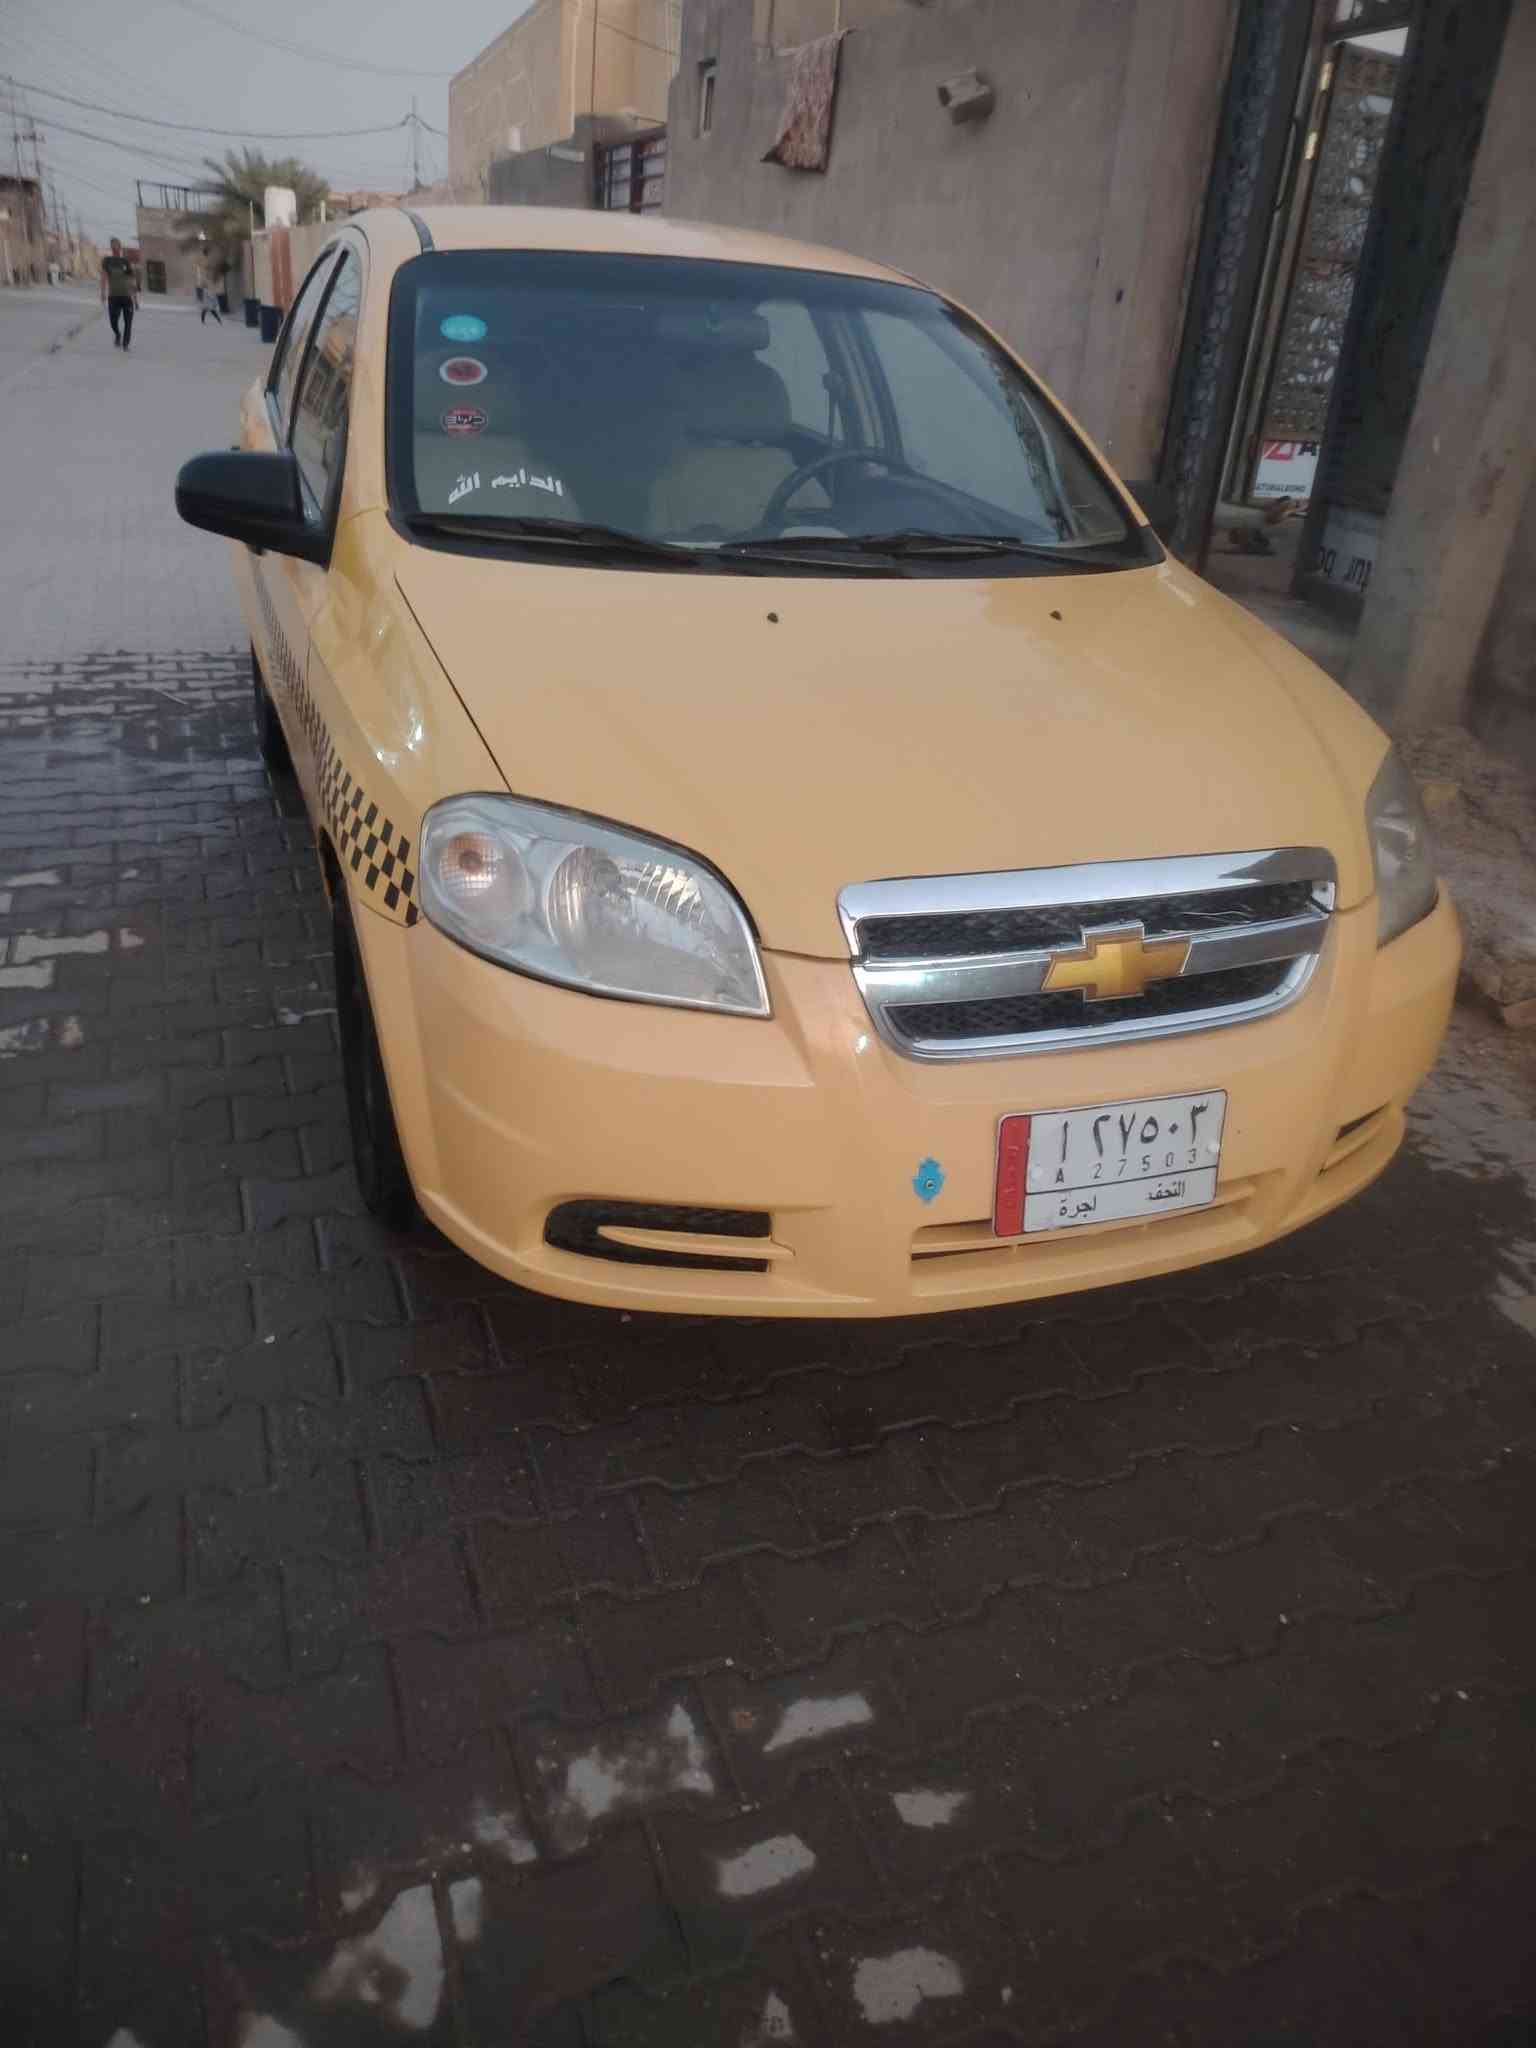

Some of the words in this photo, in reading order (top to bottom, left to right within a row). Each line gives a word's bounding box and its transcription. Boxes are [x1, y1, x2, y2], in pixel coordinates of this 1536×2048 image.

[1092, 1102, 1209, 1158] ٢٧٥٠٣
[1055, 1169, 1065, 1184] A
[1093, 1148, 1197, 1180] 27503
